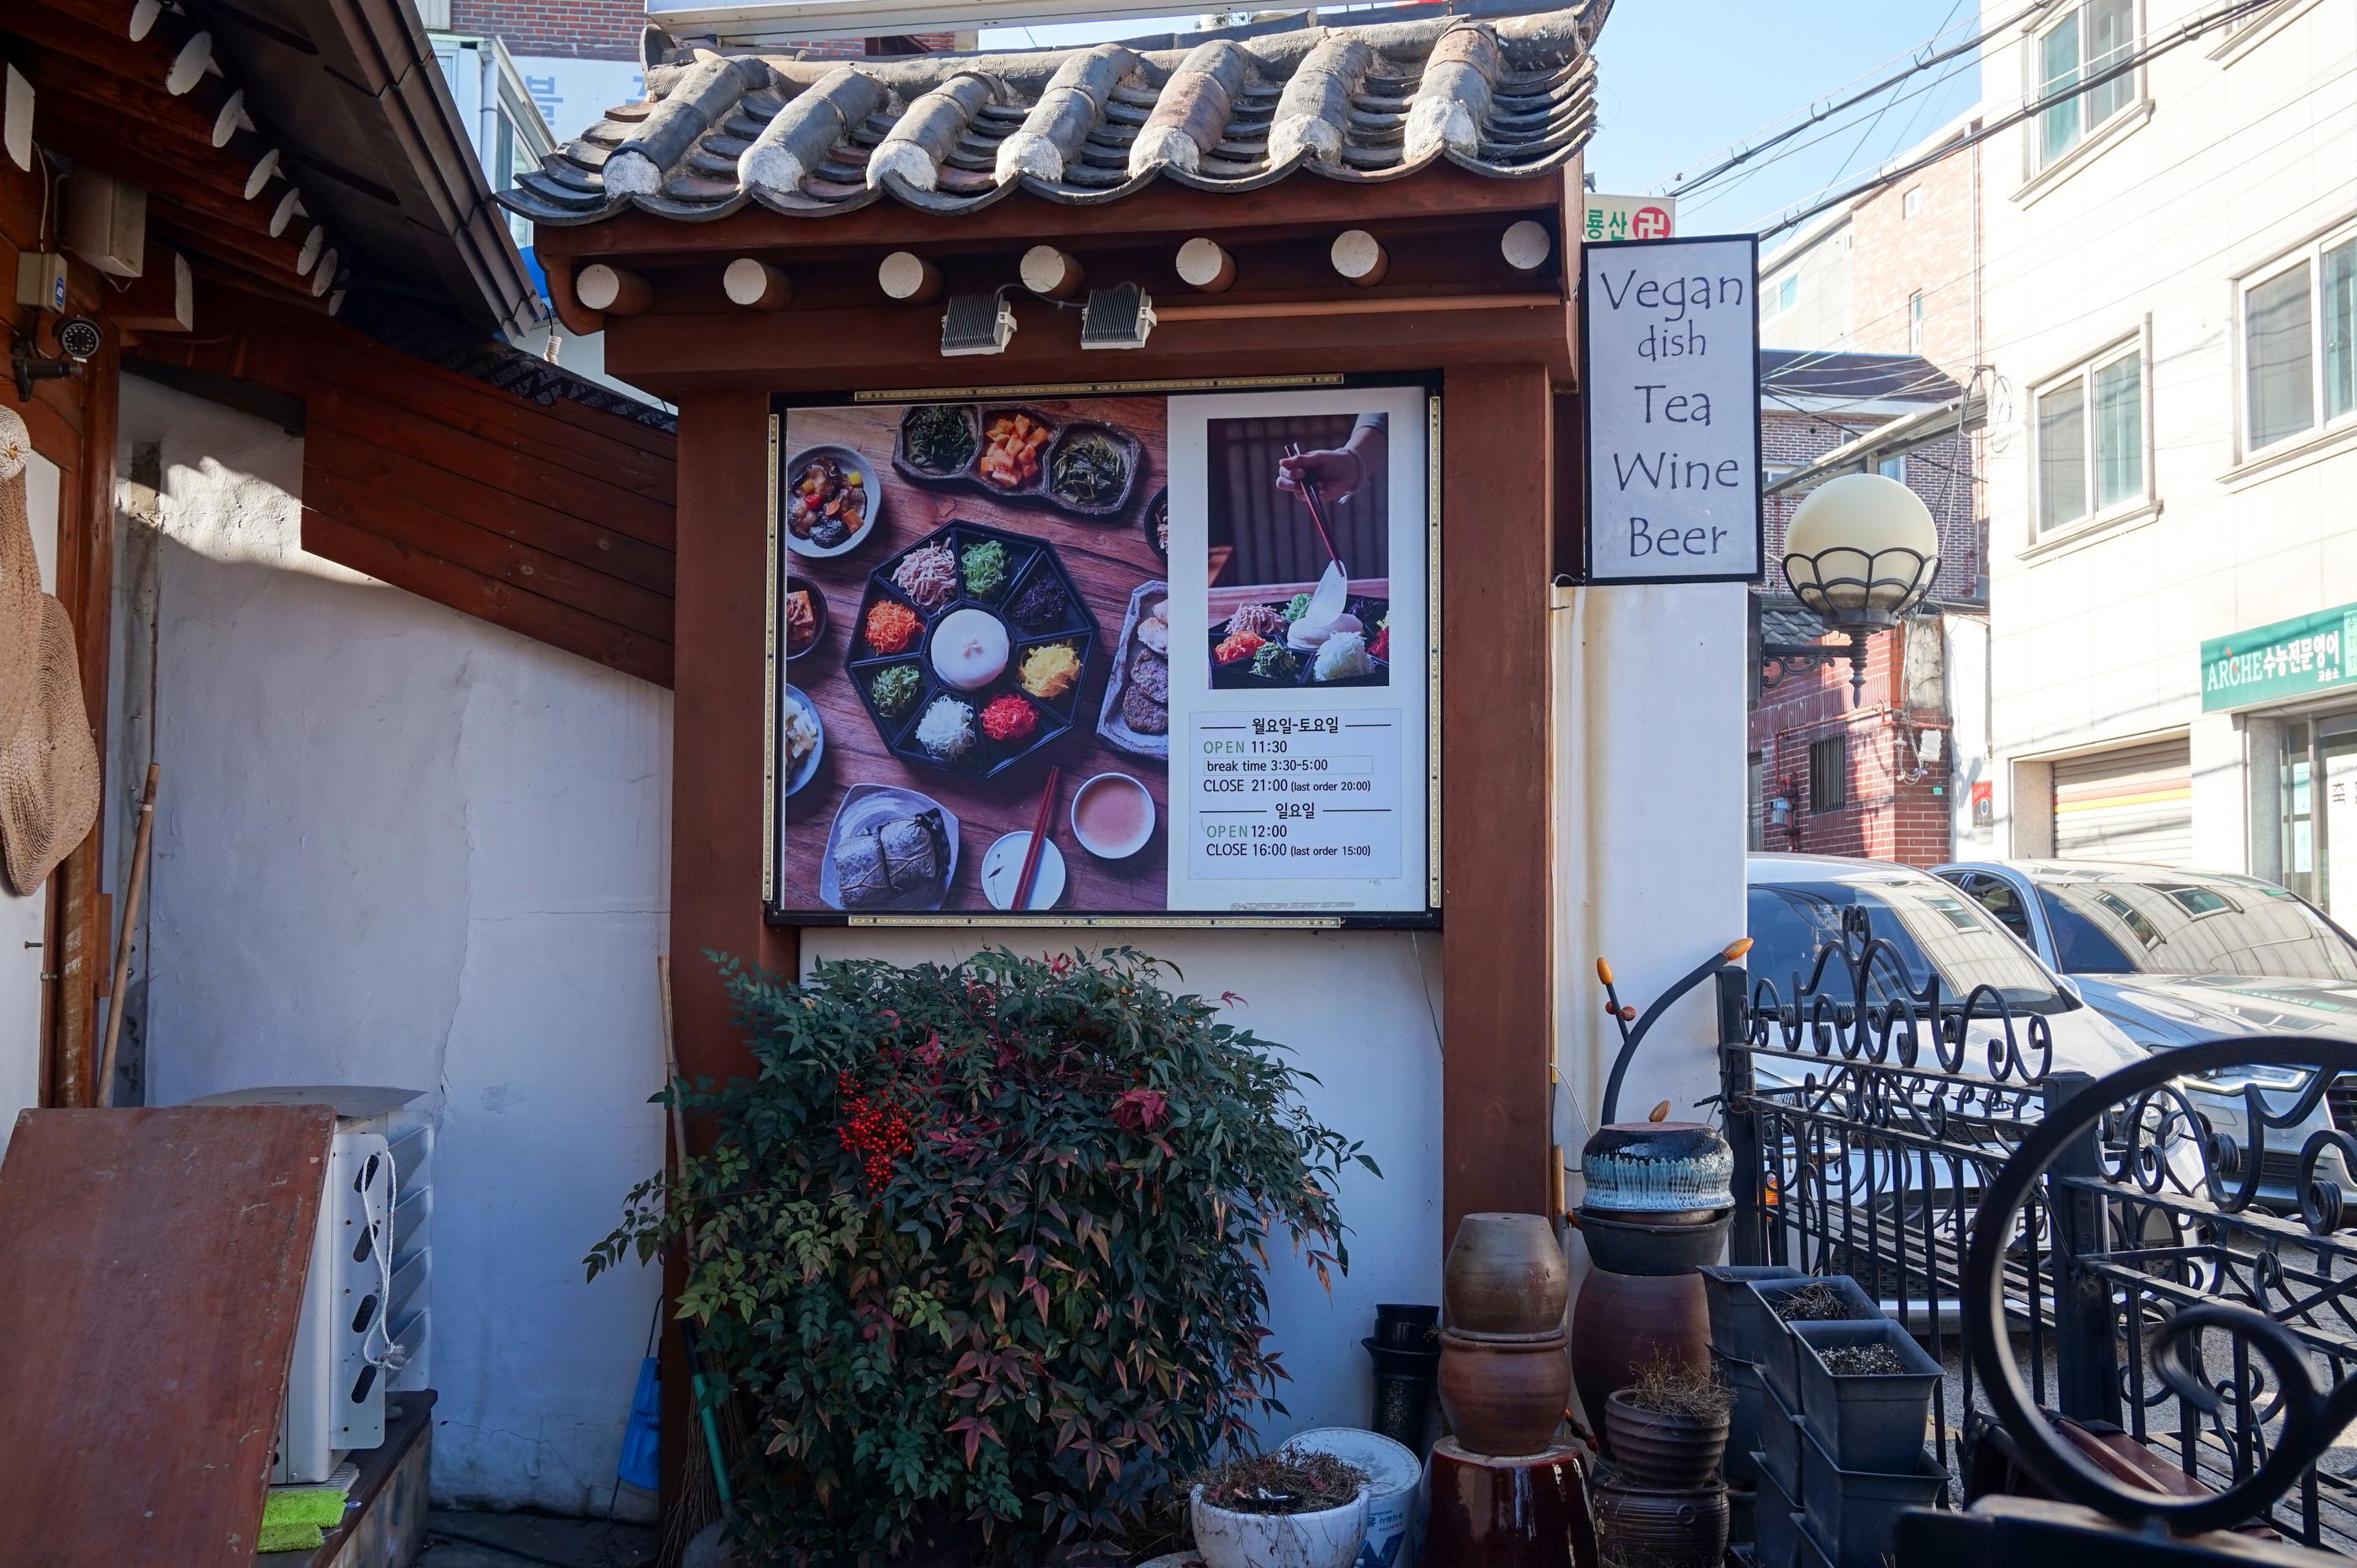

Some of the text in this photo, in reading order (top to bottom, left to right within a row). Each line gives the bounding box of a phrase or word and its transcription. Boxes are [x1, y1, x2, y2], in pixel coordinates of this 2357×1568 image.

[1600, 269, 1743, 322] Vegan
[1637, 319, 1706, 362] dish
[1634, 384, 1711, 426] Tea
[1613, 451, 1739, 491] Wine
[1629, 517, 1727, 557] Beer
[2207, 651, 2263, 692] ARCHE
[2264, 630, 2339, 679] 수능전문영어
[1252, 716, 1338, 735] 월요일-토요일
[1203, 740, 1287, 754] OPEN 11:30
[1207, 759, 1328, 772] break time 3:30-5:00
[1203, 779, 1370, 793] CLOSE 21:00 (last order 20:00)
[1275, 802, 1315, 819] 일요일
[1206, 825, 1287, 838] OPEN 12:00
[1206, 843, 1370, 858] CLOSE 16:00 (last order 15:00)
